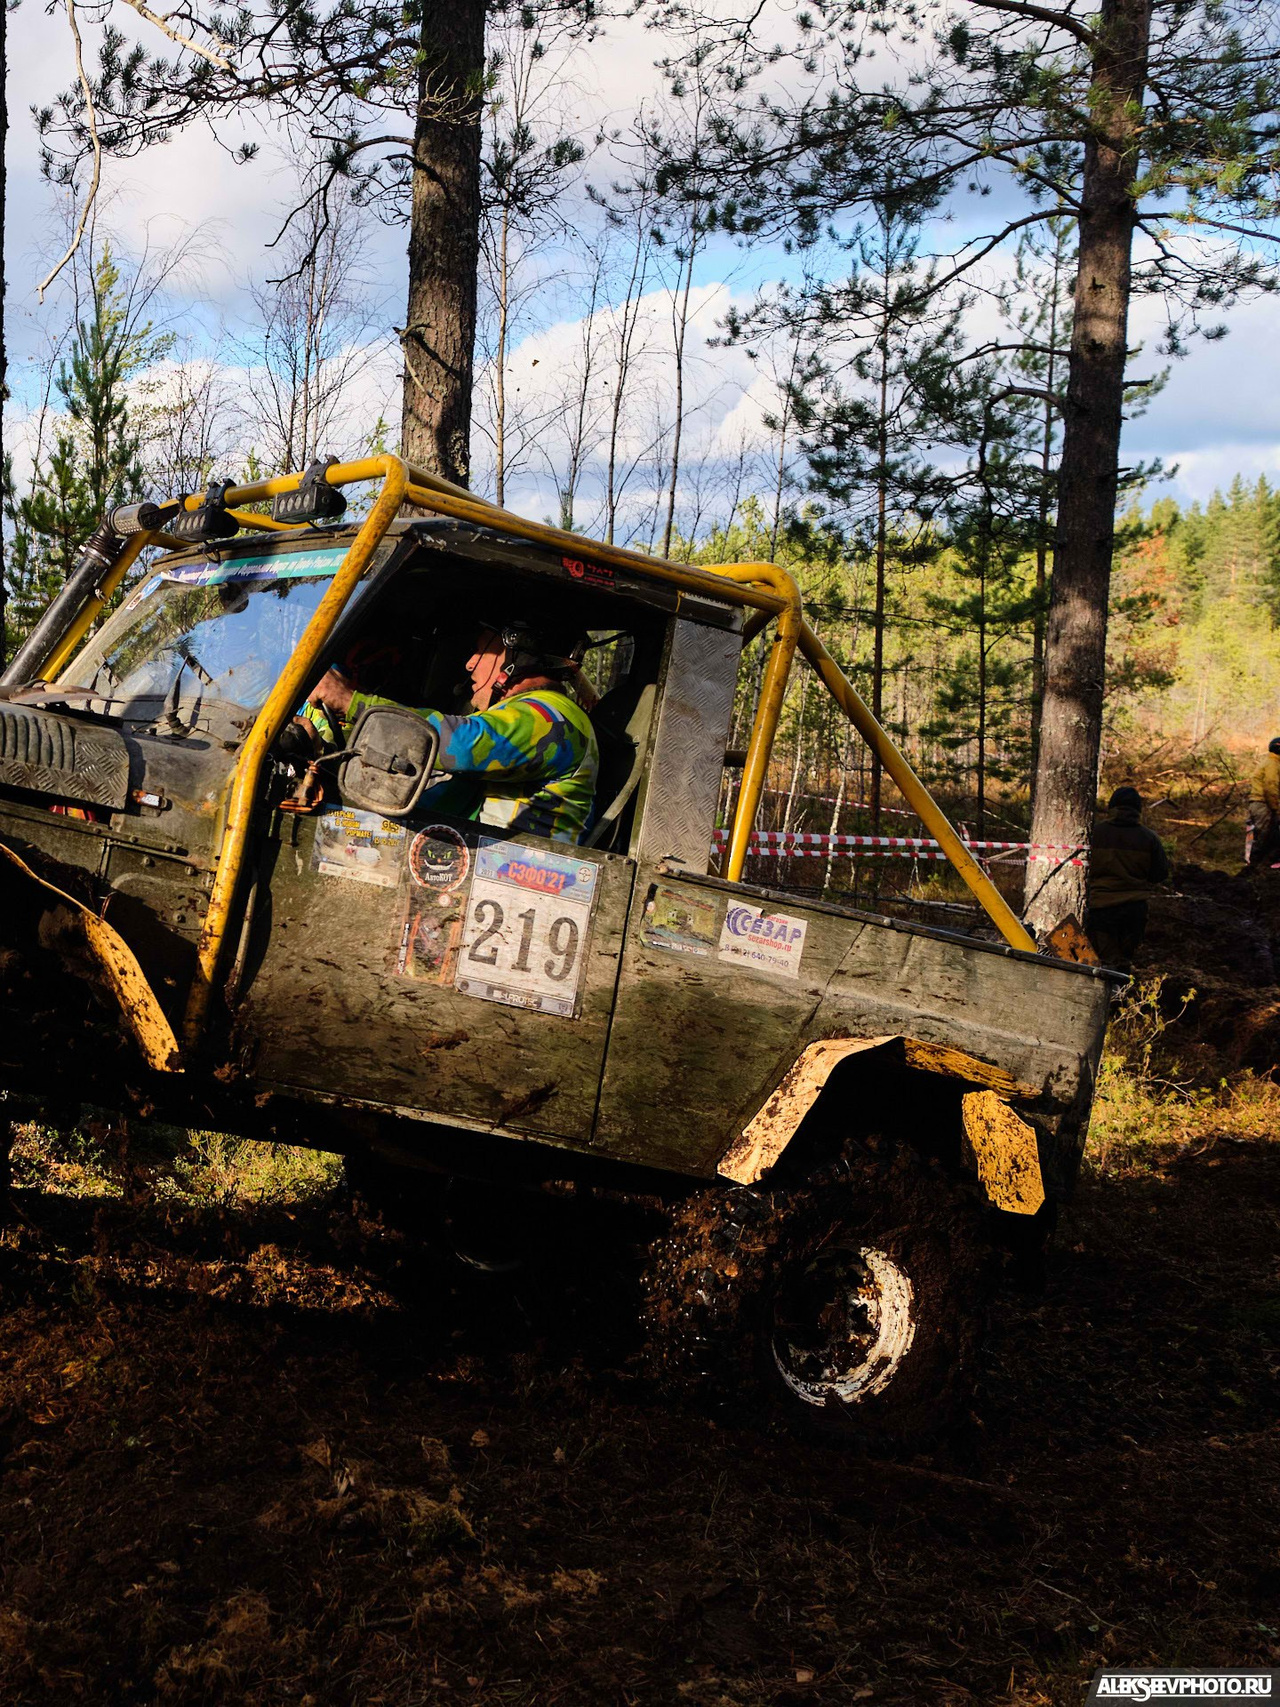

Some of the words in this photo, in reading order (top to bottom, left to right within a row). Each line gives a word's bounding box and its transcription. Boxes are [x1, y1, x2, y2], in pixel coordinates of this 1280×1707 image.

[467, 898, 580, 982] 219
[740, 914, 802, 943] СЕЗАР
[747, 934, 793, 953] sezarshop.ru
